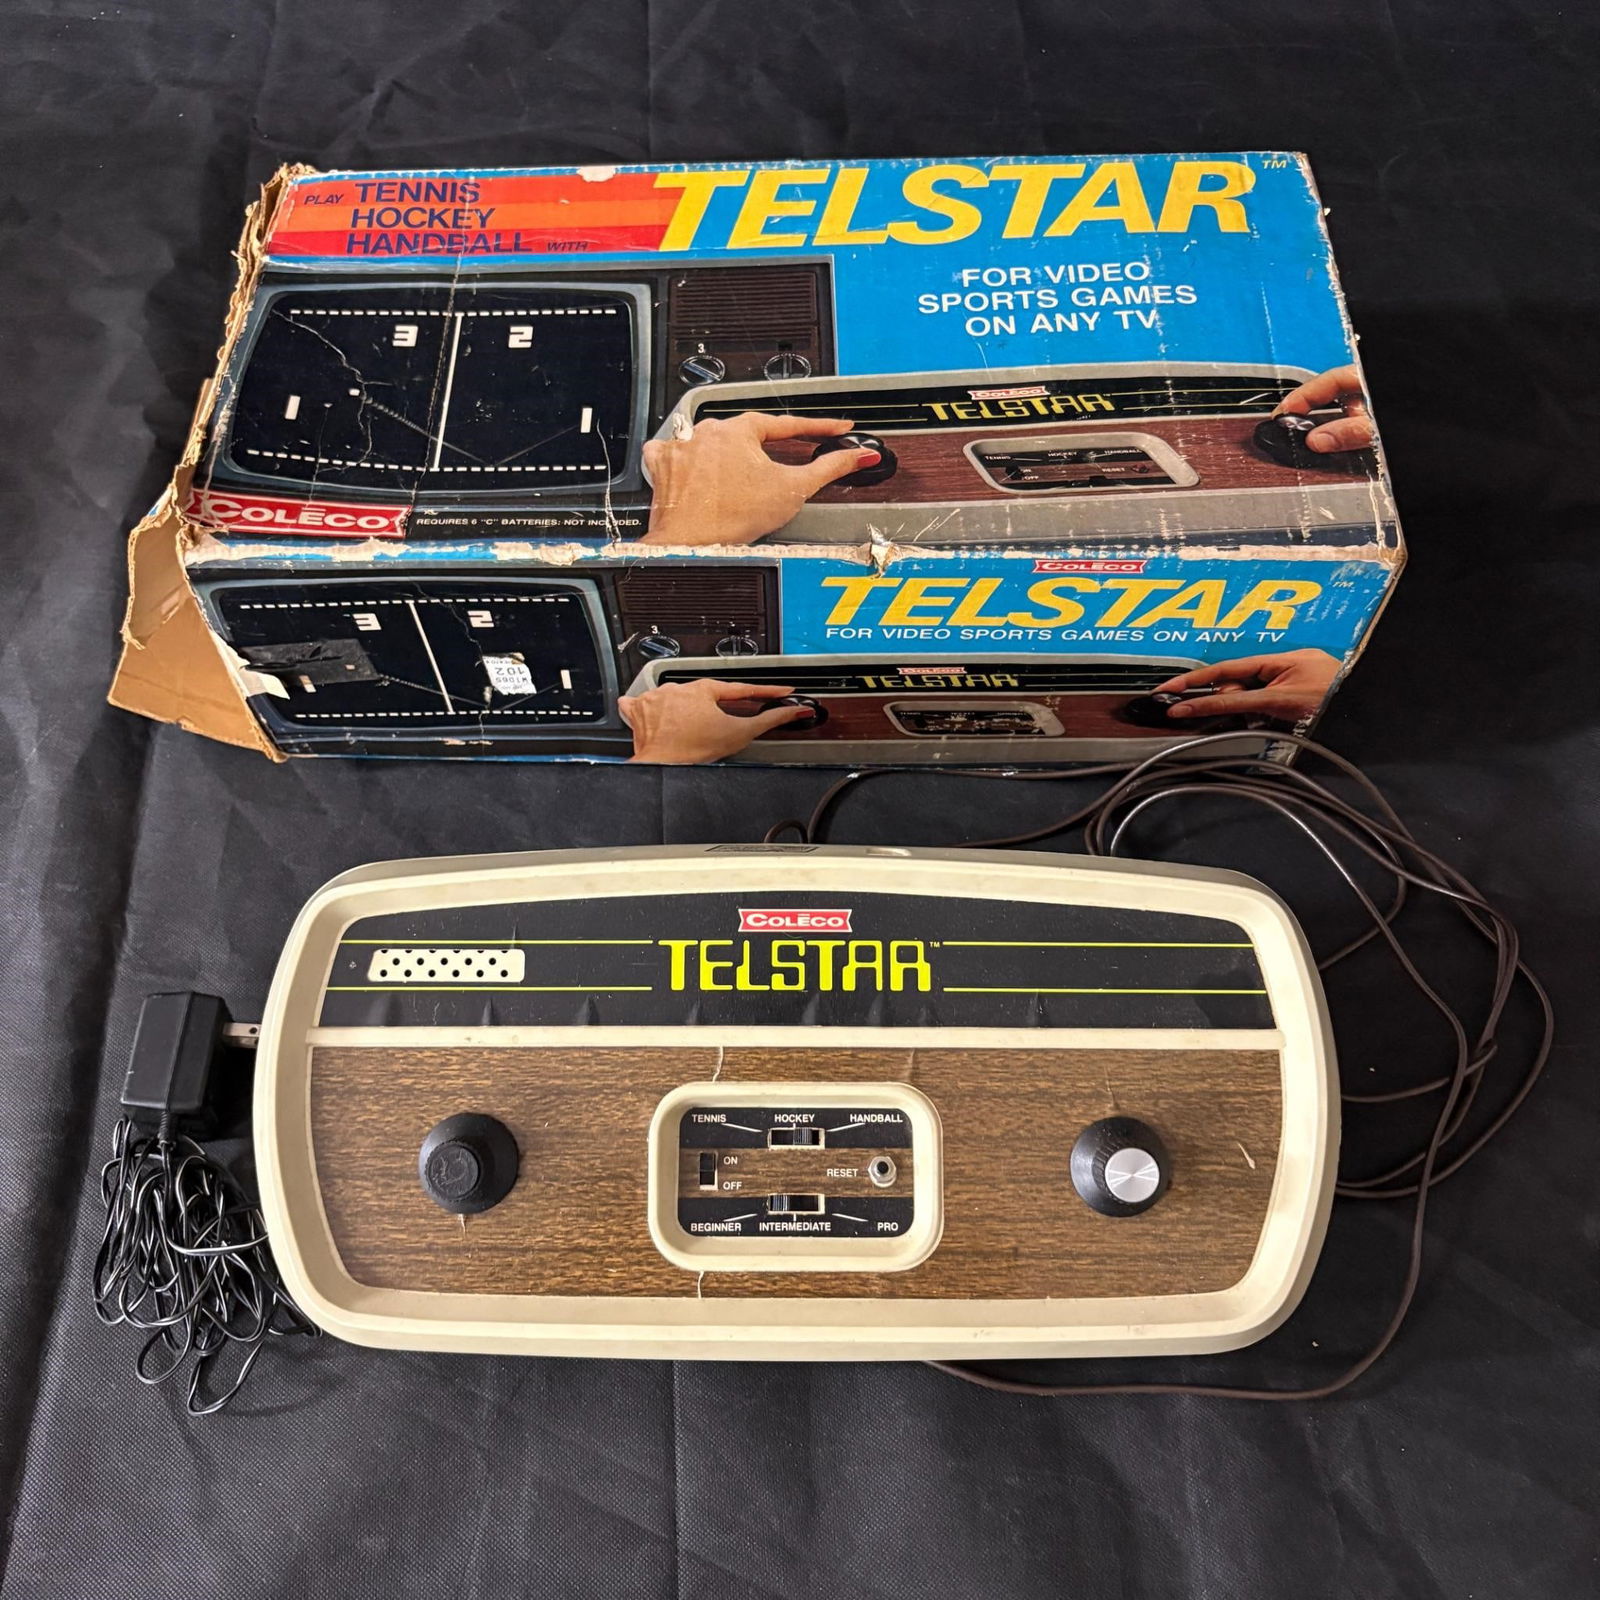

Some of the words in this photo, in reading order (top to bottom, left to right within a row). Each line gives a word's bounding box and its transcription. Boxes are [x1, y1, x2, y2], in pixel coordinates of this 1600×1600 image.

[304, 194, 345, 206] PLAY
[354, 181, 481, 204] TENNIS
[651, 160, 1256, 252] TELSTAR
[350, 206, 496, 230] HOCKEY
[345, 231, 533, 255] HANDBALL
[546, 240, 588, 252] WITH
[962, 266, 1032, 288] FOR
[1043, 261, 1150, 285] VIDEO
[918, 289, 1059, 314] SPORTS
[1070, 285, 1198, 307] GAMES
[964, 315, 1017, 337] ON
[1030, 311, 1100, 334] ANY
[1113, 309, 1157, 330] TV
[392, 324, 419, 347] 3
[508, 325, 534, 349] 2
[697, 343, 705, 353] 3
[921, 393, 1115, 421] TELSTAR
[416, 518, 469, 526] REQUIRES
[471, 518, 477, 526] 6
[480, 518, 499, 526] "C"
[820, 576, 1322, 630] TELSTAR
[352, 612, 382, 631] 3
[467, 610, 494, 628] 2
[650, 625, 658, 634] 3
[825, 627, 872, 640] FOR
[882, 628, 951, 640] VIDEO
[959, 628, 1052, 641] SPORTS
[1061, 629, 1145, 642] GAMES
[1153, 629, 1189, 642] ON
[1195, 630, 1245, 642] ANY
[1256, 631, 1286, 643] TV
[856, 674, 1019, 689] TELSTAR
[658, 939, 932, 992] TELSTAR
[692, 1113, 727, 1124] TENNIS
[774, 1113, 815, 1123] HOCKEY
[849, 1113, 904, 1123] HANDBALL
[723, 1156, 738, 1165] ON
[826, 1168, 859, 1178] RESET
[722, 1181, 743, 1190] OFF
[690, 1222, 742, 1232] BEGINNER
[759, 1222, 832, 1232] INTERMEDIATE
[877, 1222, 899, 1232] PRO
